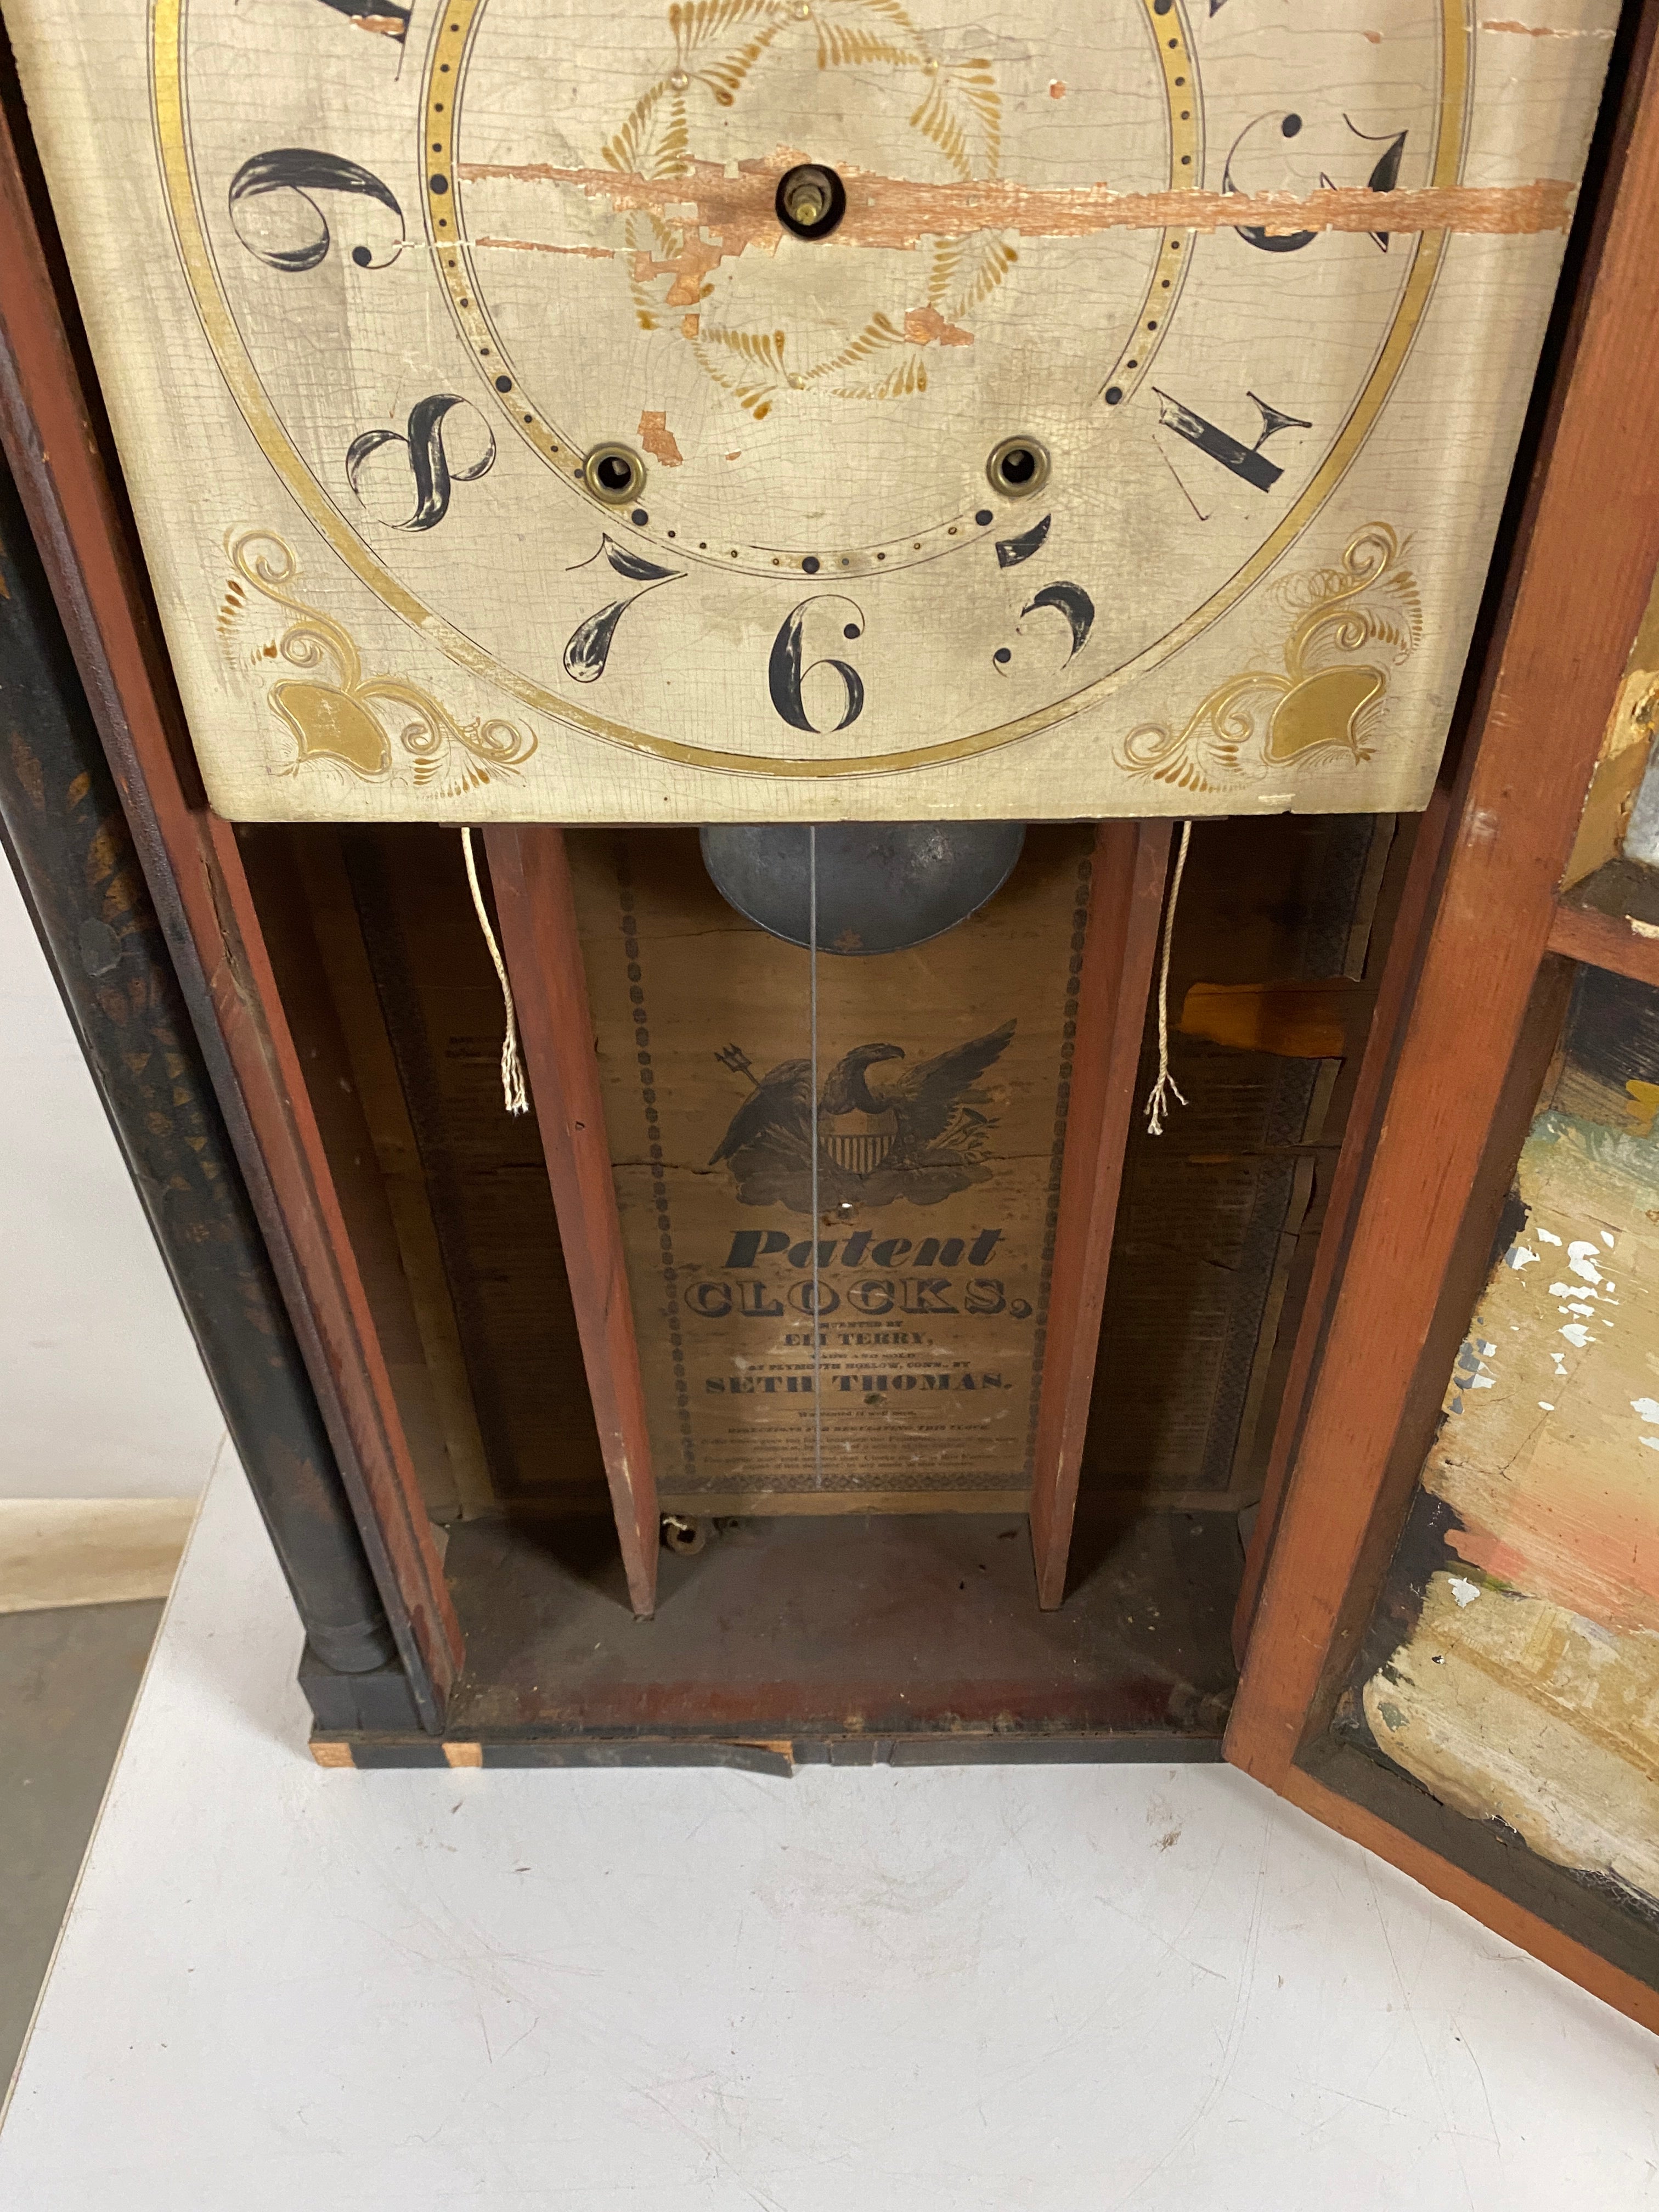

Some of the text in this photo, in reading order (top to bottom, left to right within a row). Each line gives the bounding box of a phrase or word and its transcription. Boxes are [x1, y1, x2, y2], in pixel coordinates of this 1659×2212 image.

[229, 147, 406, 272] 9
[346, 393, 496, 532] 8
[1152, 386, 1313, 522] 4
[564, 532, 689, 683] 7
[992, 514, 1095, 678] 5
[768, 594, 866, 733] 6
[684, 1278, 1034, 1319] CLOCKS,
[721, 1228, 1007, 1269] Patent
[705, 1372, 1013, 1394] SETH THOMAS.
[783, 1331, 933, 1347] ELI TERRY,
